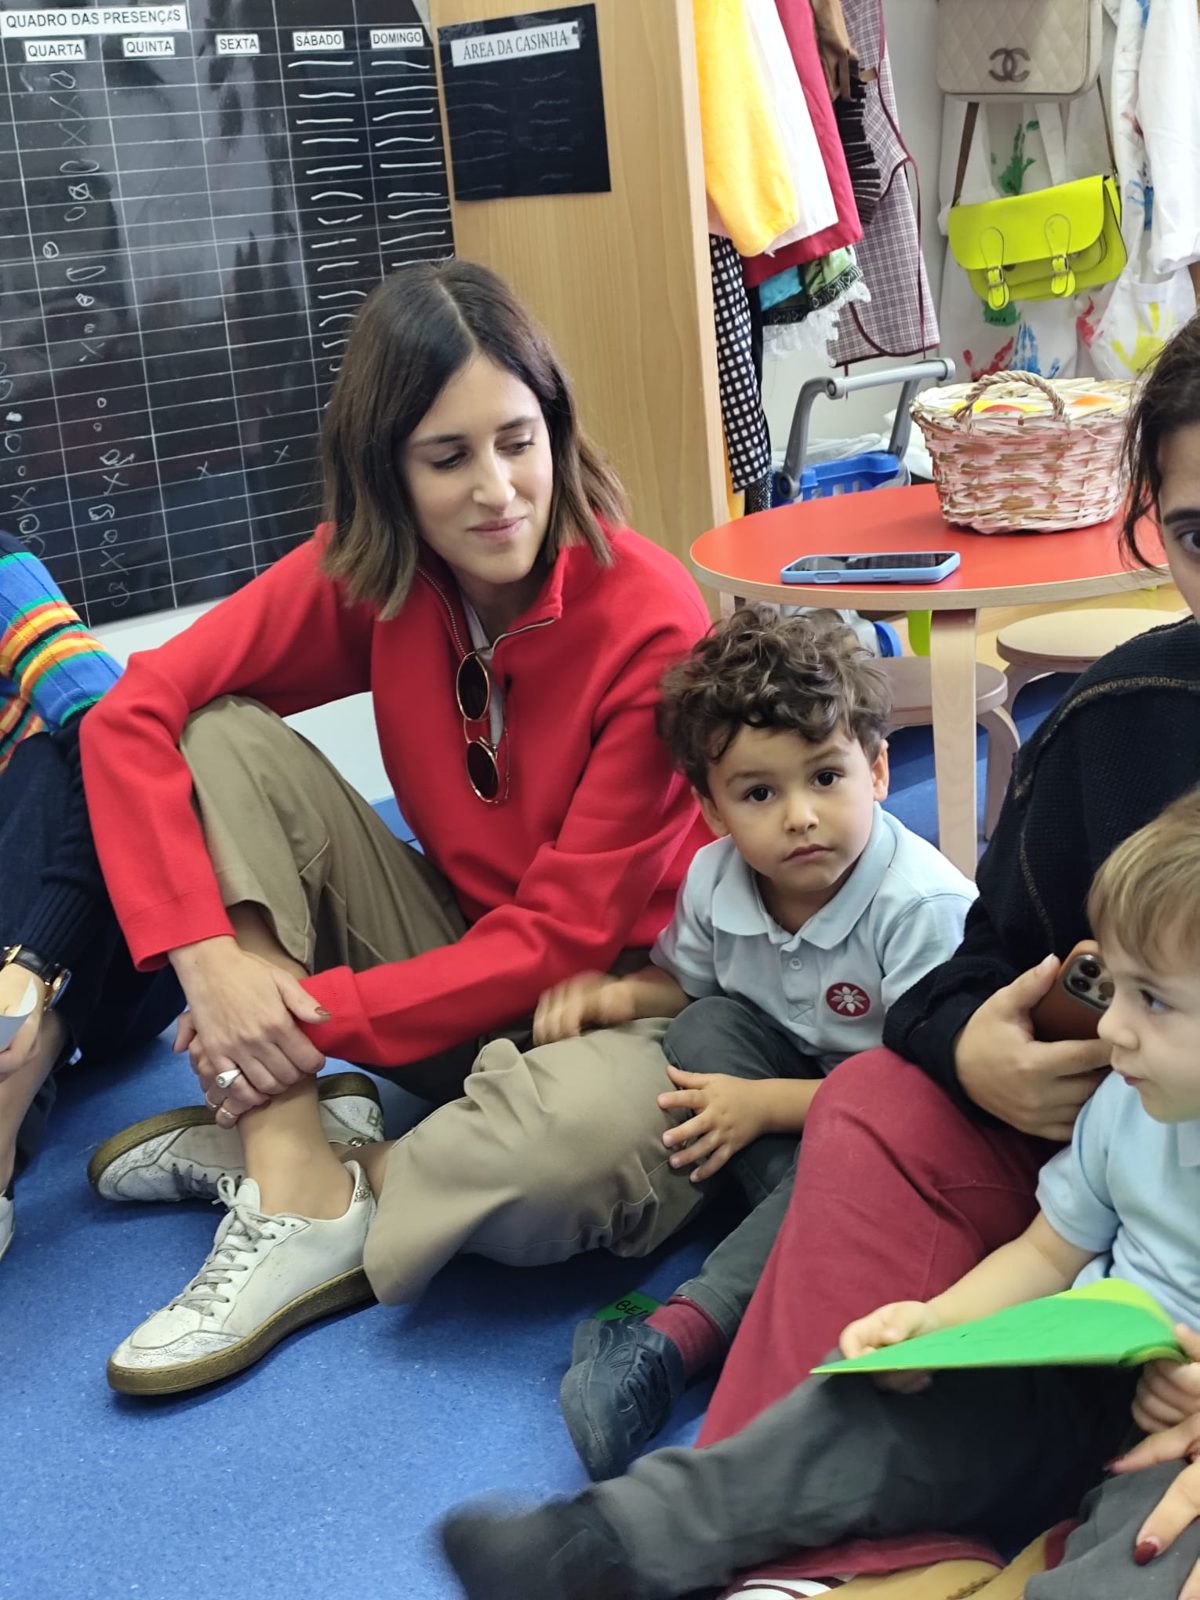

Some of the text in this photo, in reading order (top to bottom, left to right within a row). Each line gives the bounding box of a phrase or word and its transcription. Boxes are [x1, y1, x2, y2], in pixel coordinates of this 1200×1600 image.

[6, 9, 181, 28] QUADRO DAS PRESENÇAS
[219, 38, 257, 50] SEXTA
[296, 32, 342, 47] SÁBADO
[372, 31, 422, 45] DOMINGO
[463, 30, 568, 60] ÁREA DA CASINHA
[28, 43, 83, 58] QUARTA
[126, 40, 173, 54] QUINTA
